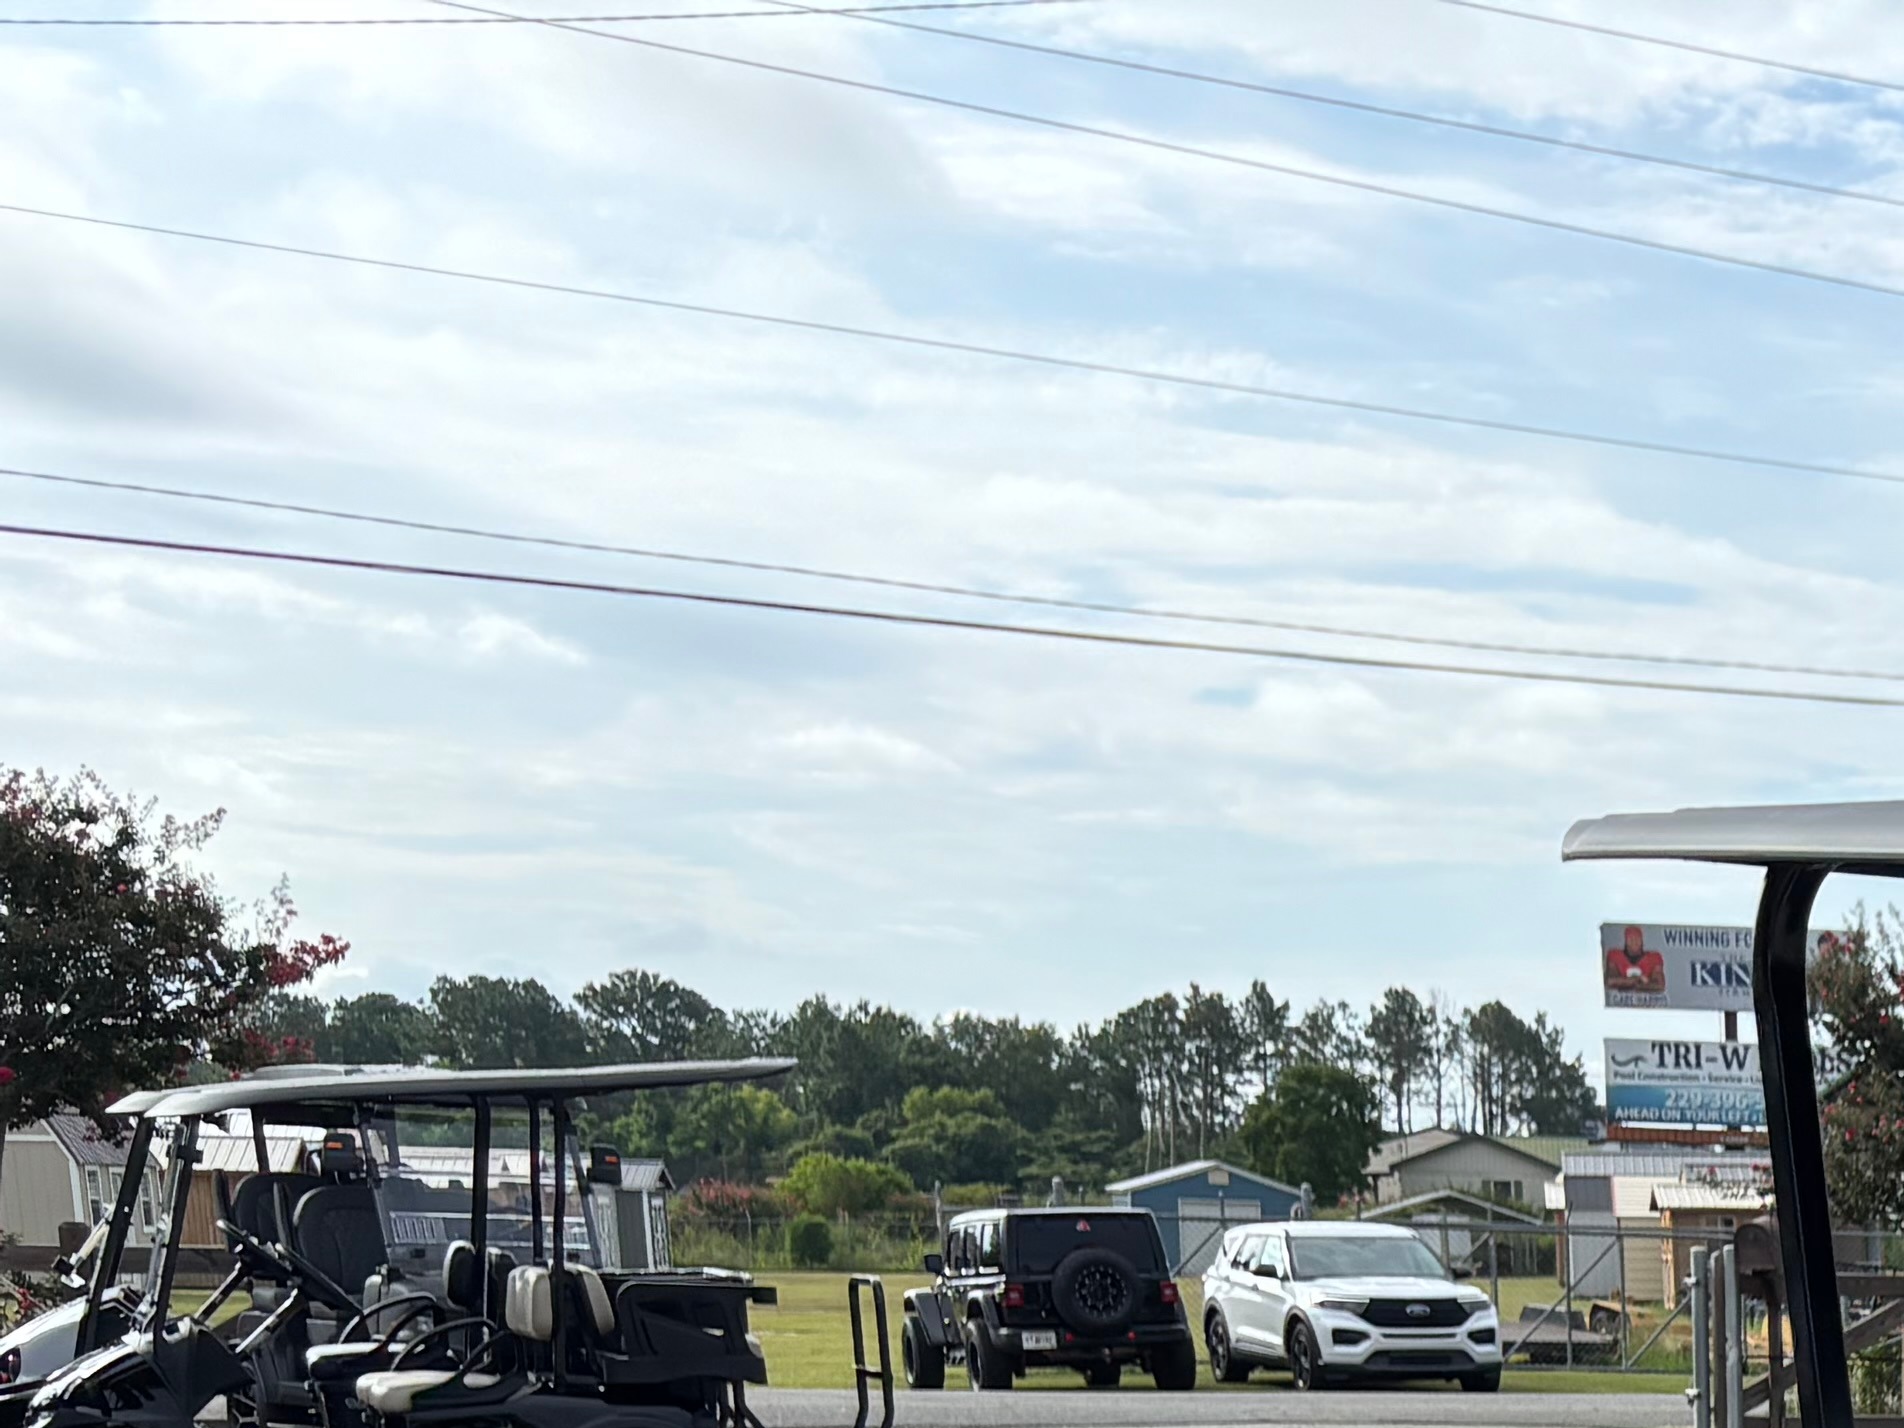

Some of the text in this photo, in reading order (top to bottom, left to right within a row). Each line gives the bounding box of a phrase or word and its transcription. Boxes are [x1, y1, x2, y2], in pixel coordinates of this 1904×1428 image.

[1664, 929, 1730, 948] WINNING
[1693, 961, 1752, 986] KIN
[1652, 1042, 1751, 1071] TRI-W
[1615, 1106, 1659, 1120] AHEAD
[1661, 1107, 1681, 1121] ON
[1685, 1108, 1721, 1122] YOUR
[1722, 1109, 1751, 1123] LEFT
